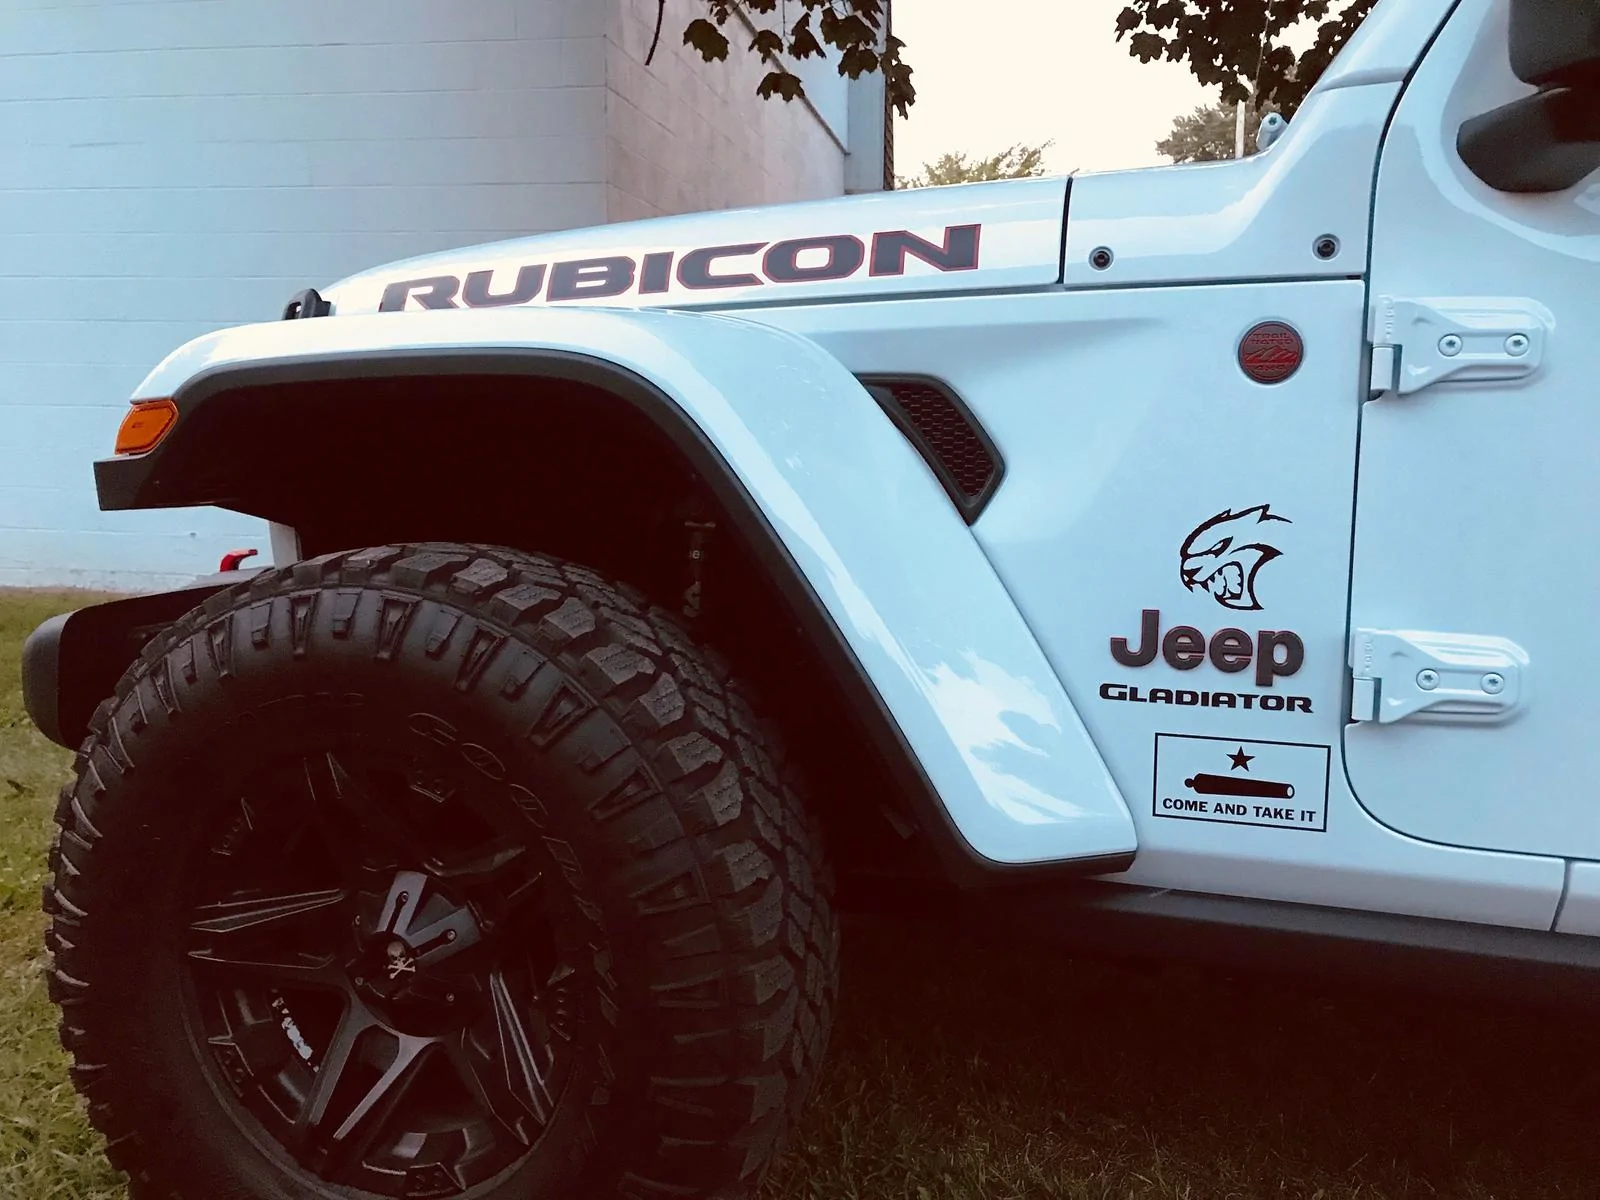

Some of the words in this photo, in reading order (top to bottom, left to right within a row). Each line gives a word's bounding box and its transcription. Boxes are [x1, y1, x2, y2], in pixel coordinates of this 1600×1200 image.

[378, 223, 982, 312] RUBICON
[1110, 608, 1305, 687] Jeep
[1099, 682, 1314, 714] GLADIATOR
[1162, 797, 1208, 813] COME
[1213, 802, 1248, 816] AND
[1252, 805, 1295, 821] TAKE
[1300, 810, 1317, 823] IT
